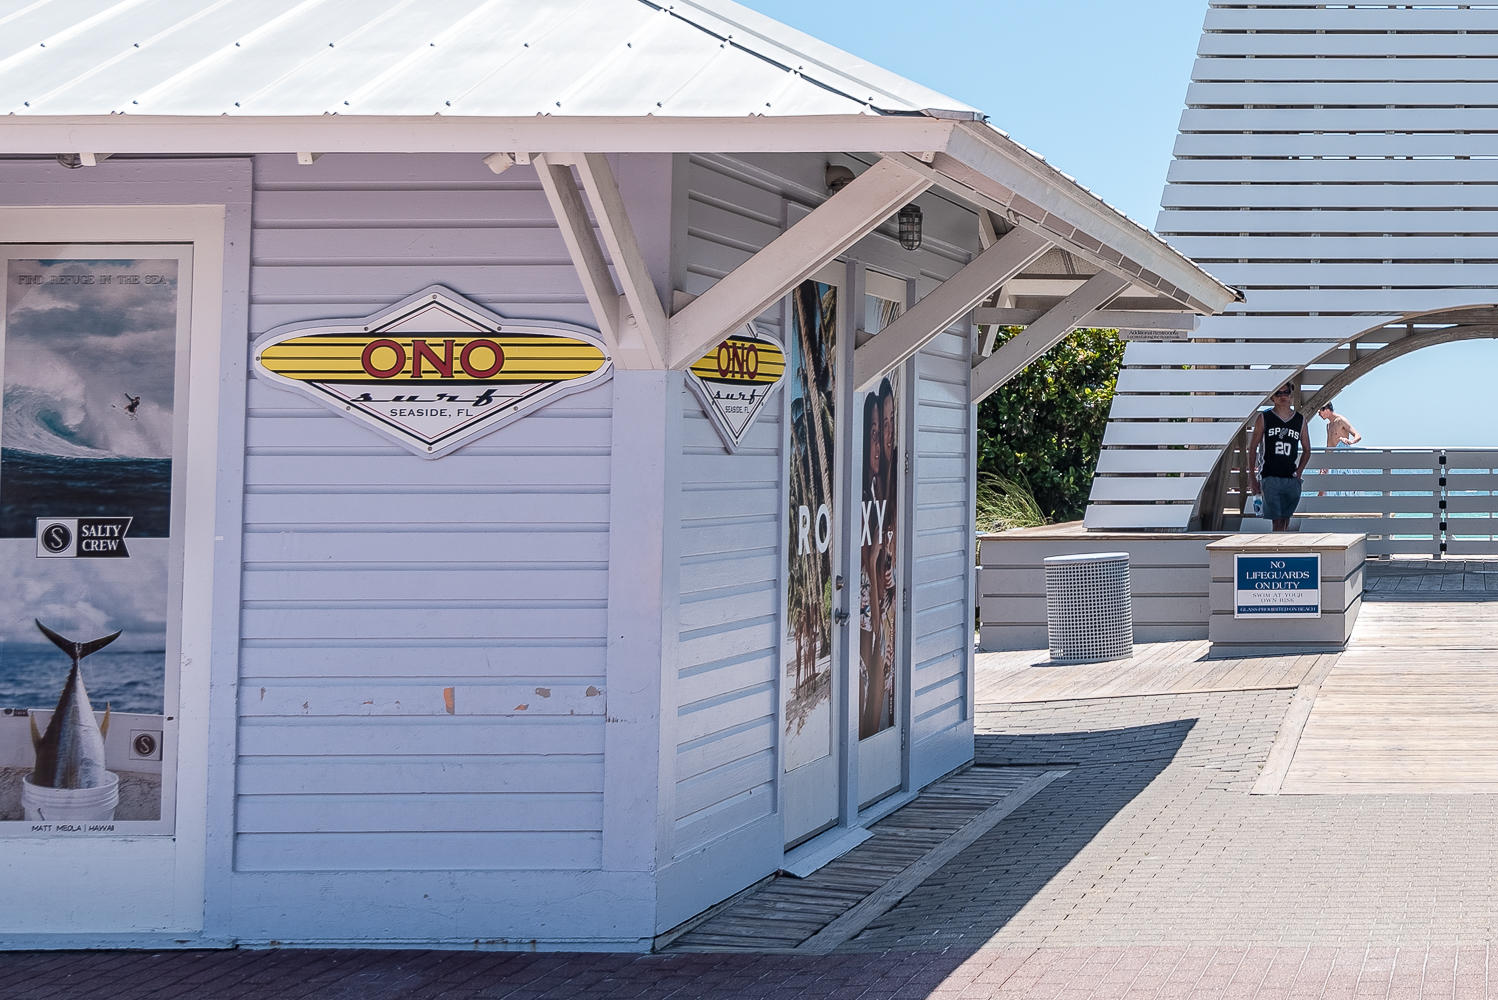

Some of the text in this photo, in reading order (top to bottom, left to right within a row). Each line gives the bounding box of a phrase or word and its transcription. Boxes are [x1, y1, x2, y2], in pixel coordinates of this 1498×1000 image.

[18, 274, 167, 285] FIND REFUGE IN THE SEA
[361, 339, 505, 379] ONO
[717, 340, 759, 379] ONO
[352, 388, 523, 407] surf
[714, 388, 764, 405] surf
[390, 408, 474, 418] SEASIDE, FL
[1275, 441, 1291, 456] 20
[82, 524, 122, 537] SALTY
[82, 539, 120, 551] CREW
[1270, 561, 1286, 569] NO
[1246, 571, 1310, 580] LIFEGUARDS
[1272, 581, 1300, 589] DUTY
[31, 824, 52, 832] MATT
